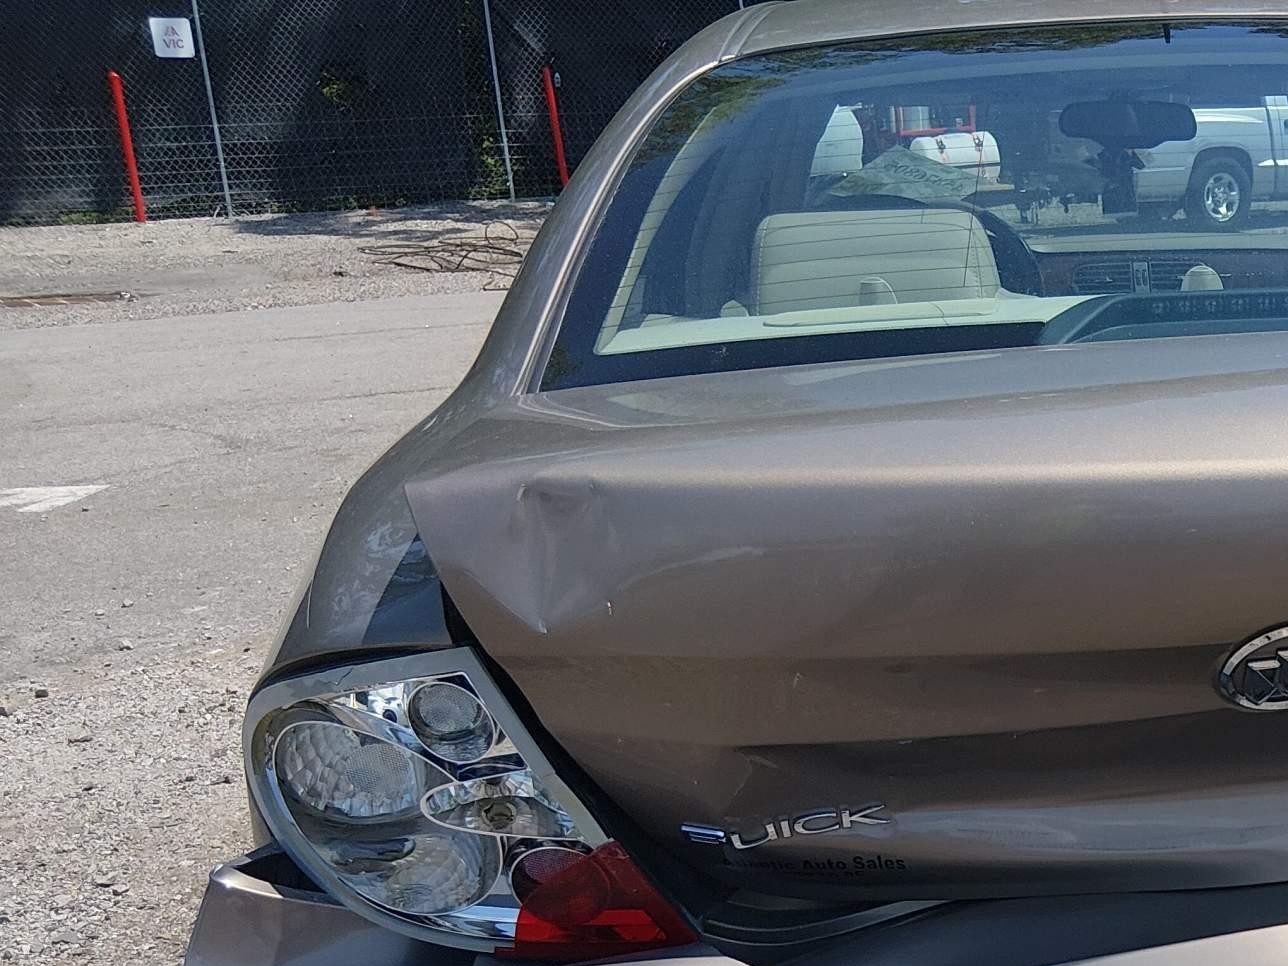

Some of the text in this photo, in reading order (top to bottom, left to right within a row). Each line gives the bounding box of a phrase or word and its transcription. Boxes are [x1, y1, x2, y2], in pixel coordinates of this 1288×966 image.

[162, 38, 184, 49] VIC
[802, 857, 847, 871] Auto
[852, 855, 906, 871] Sales
